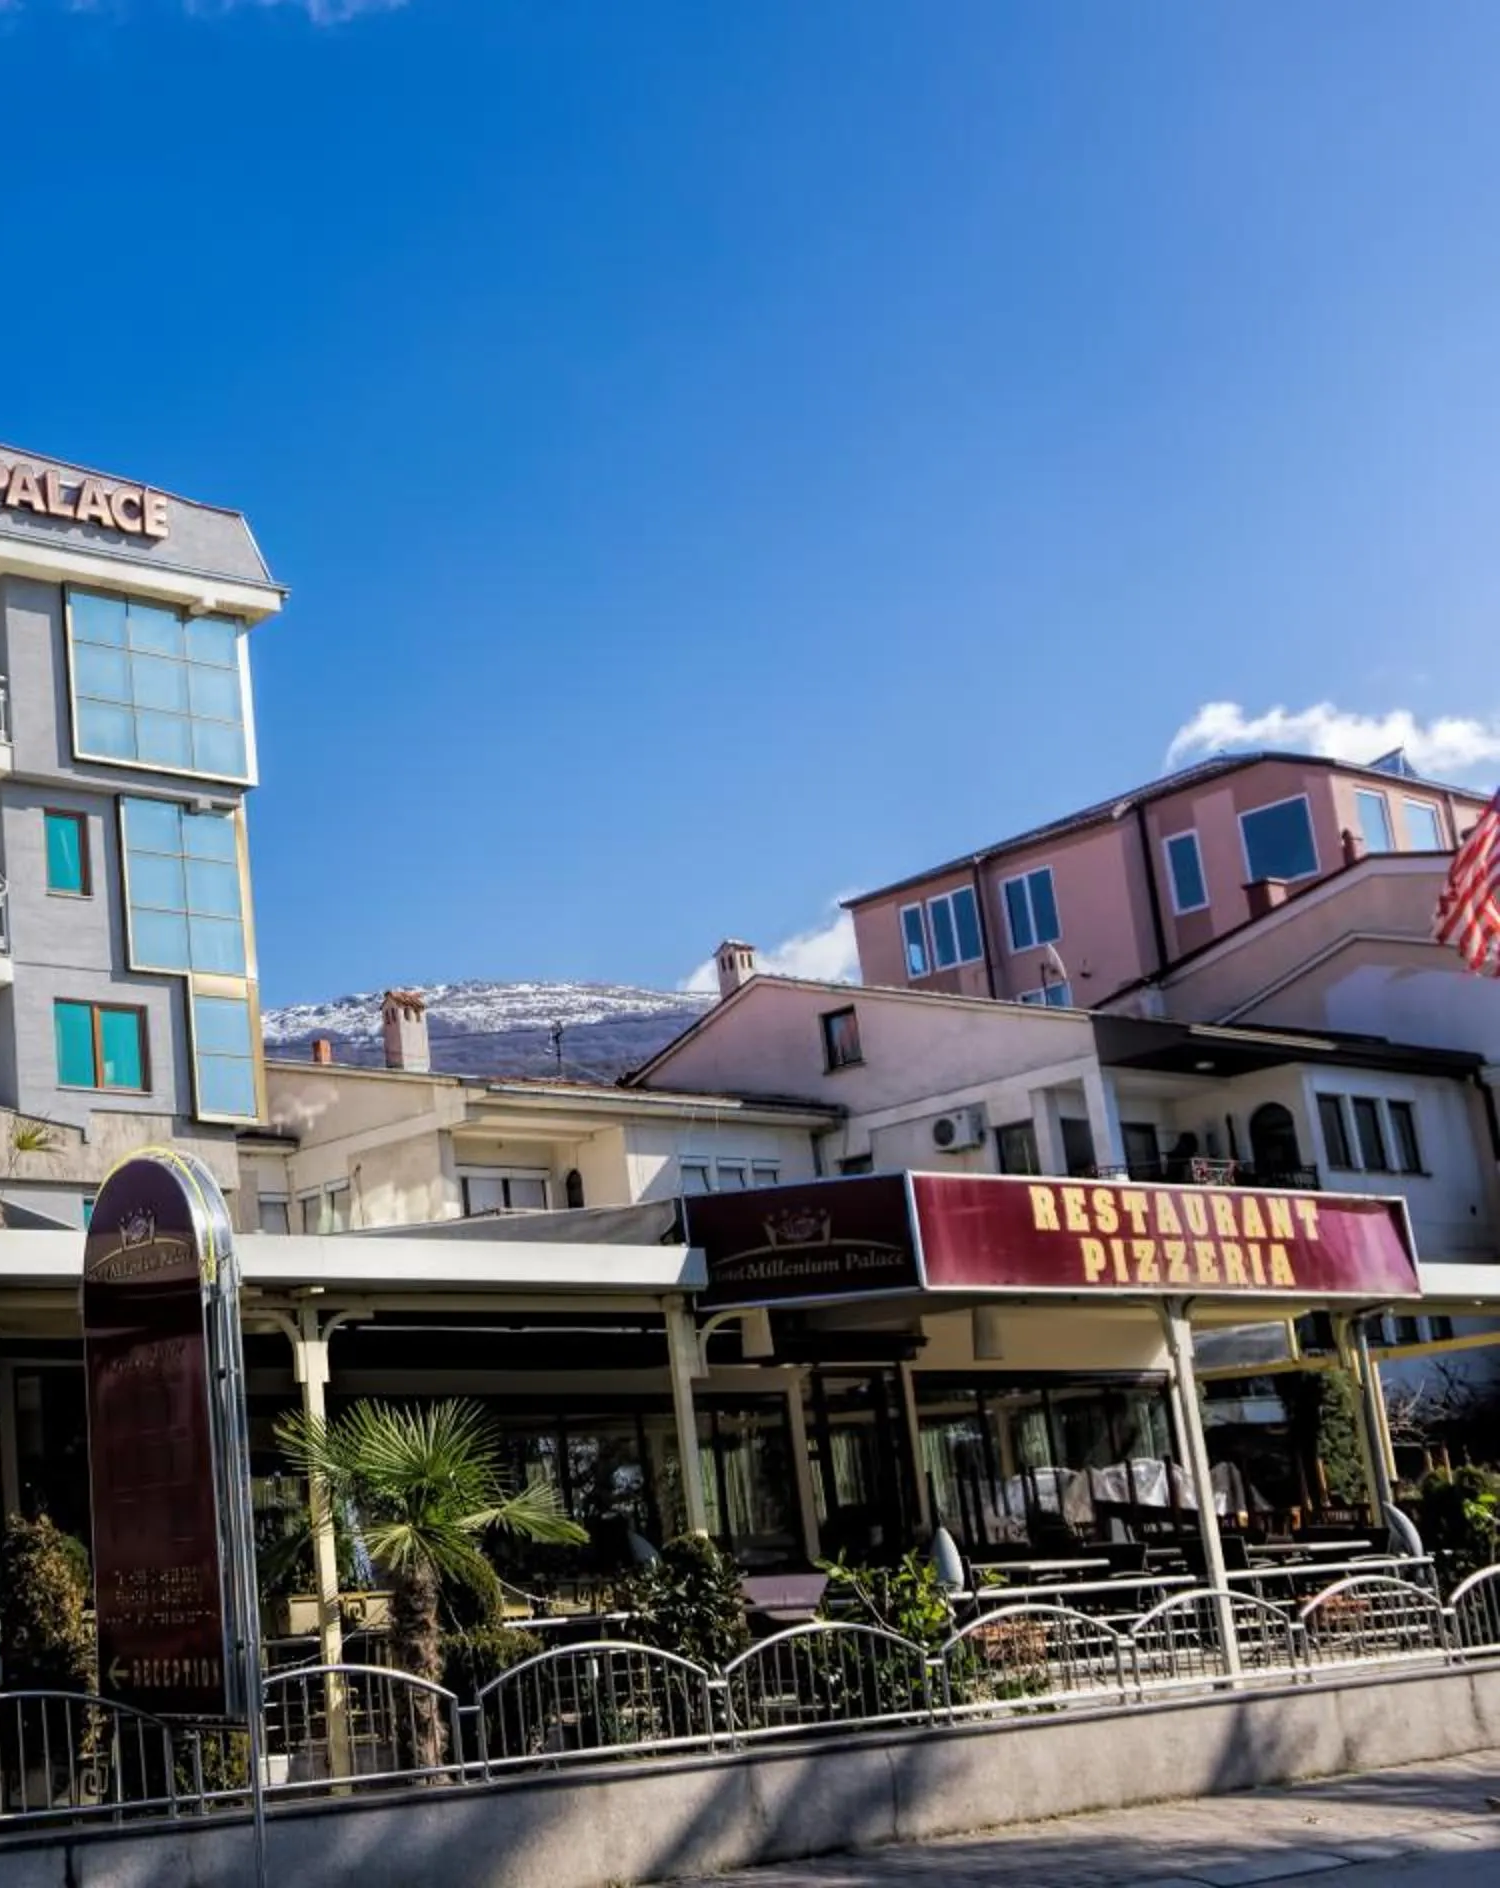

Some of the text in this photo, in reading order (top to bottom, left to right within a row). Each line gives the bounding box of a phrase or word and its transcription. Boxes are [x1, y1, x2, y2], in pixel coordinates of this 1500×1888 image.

[1028, 1184, 1320, 1241] RESTAURANT
[746, 1257, 840, 1280] Millenium
[845, 1248, 905, 1271] Palace
[1079, 1237, 1297, 1286] PIZZERIA
[131, 1656, 221, 1689] RECEPTION
